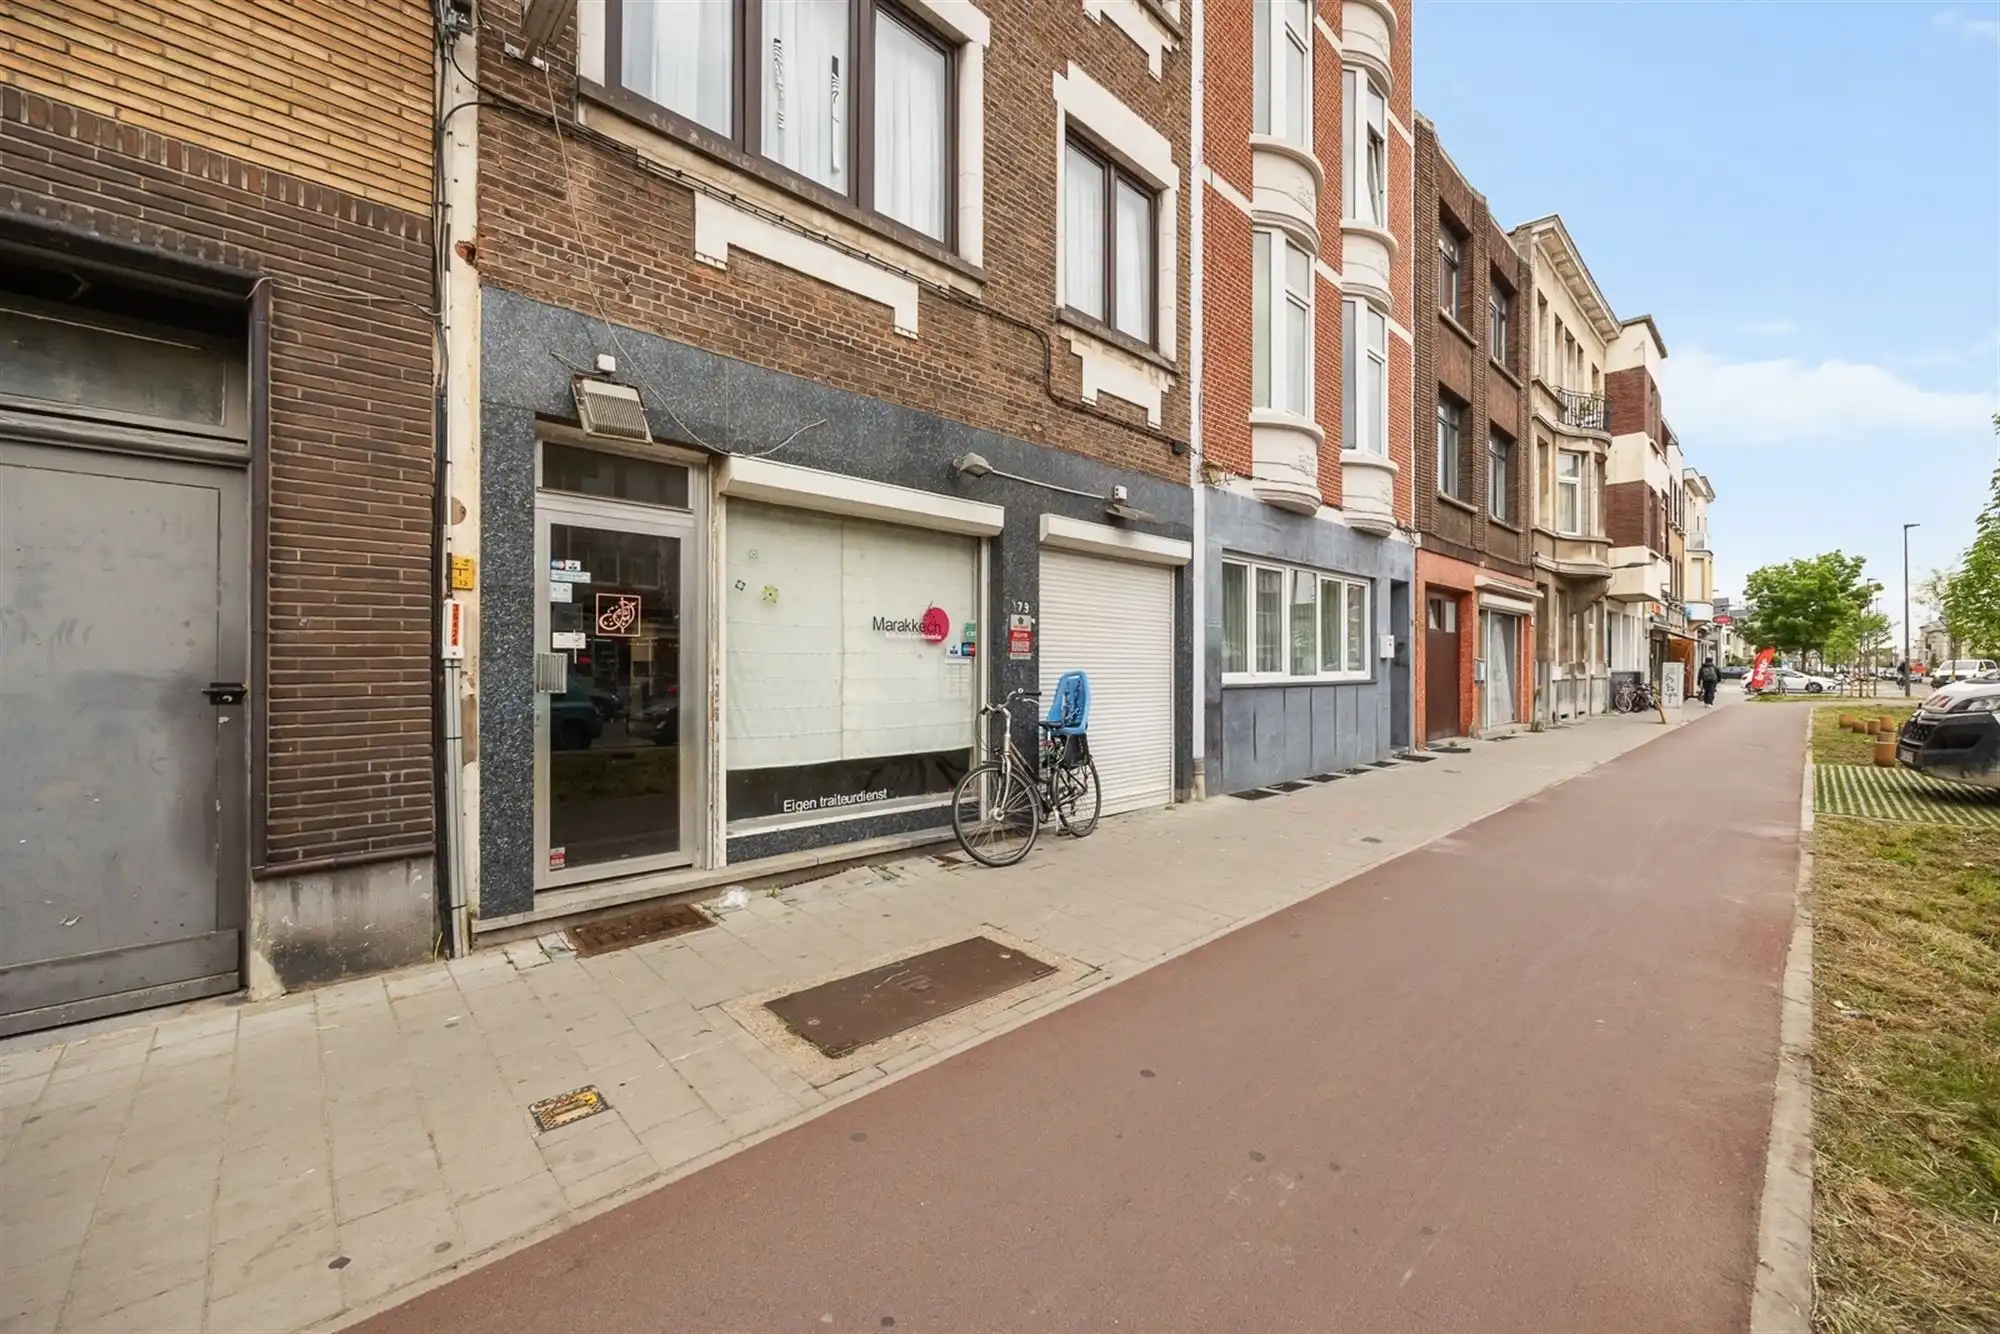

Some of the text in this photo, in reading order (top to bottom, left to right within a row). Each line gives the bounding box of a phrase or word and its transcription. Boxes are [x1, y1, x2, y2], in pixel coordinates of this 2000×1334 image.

[872, 615, 941, 633] Marakkech
[783, 788, 888, 814] Eigen traiteurdienst
